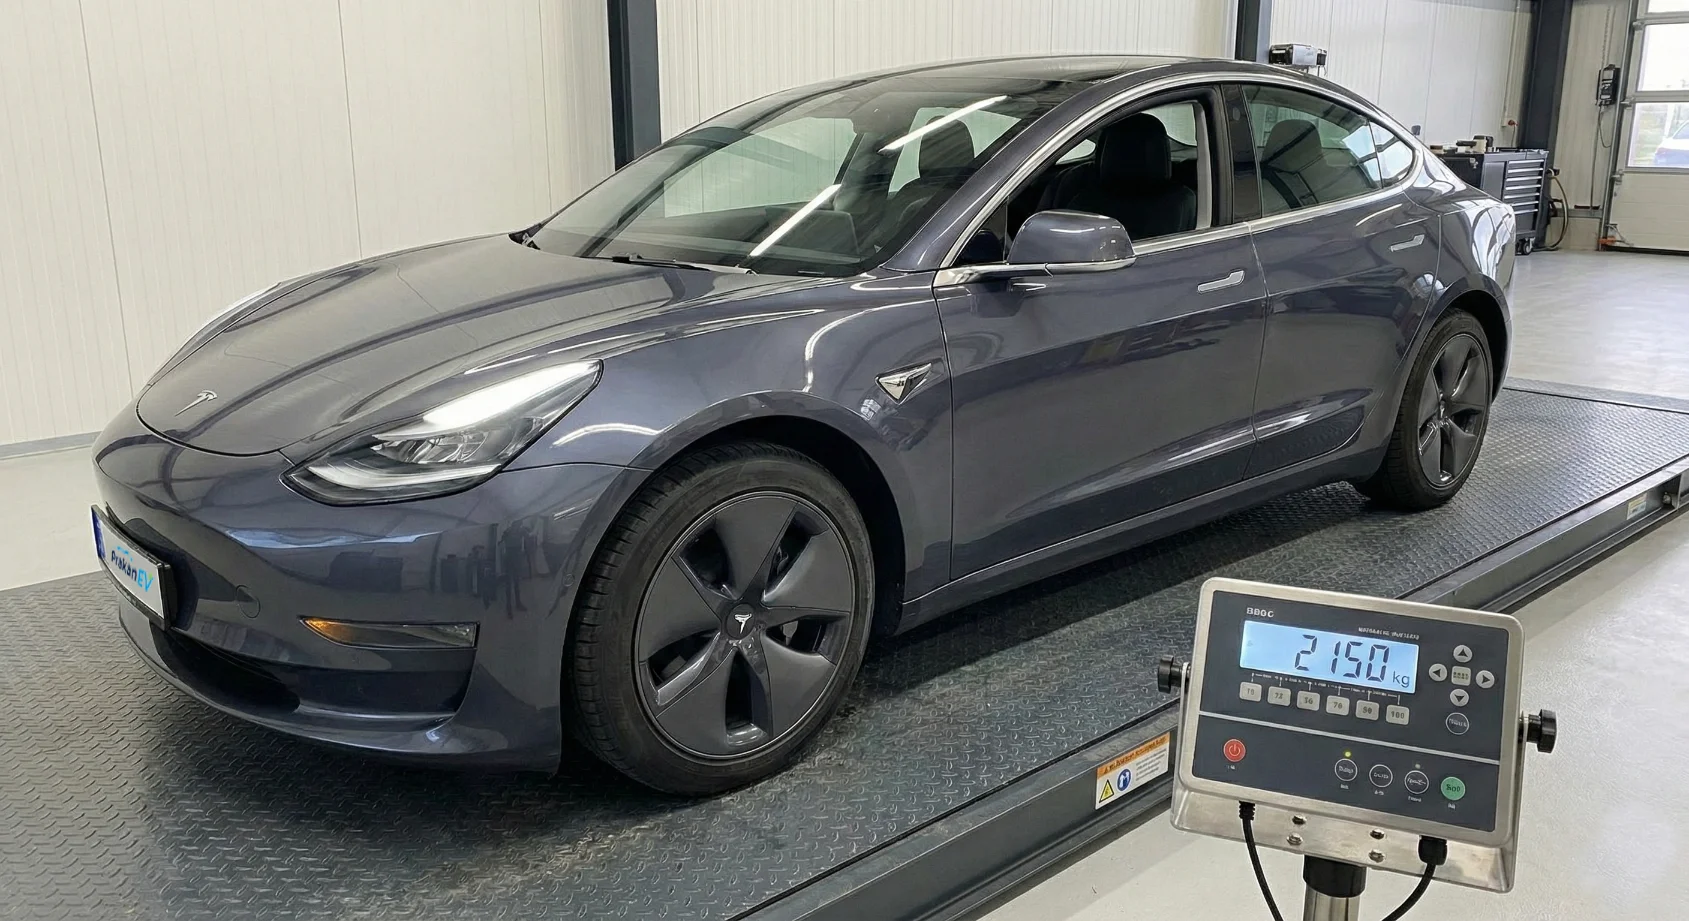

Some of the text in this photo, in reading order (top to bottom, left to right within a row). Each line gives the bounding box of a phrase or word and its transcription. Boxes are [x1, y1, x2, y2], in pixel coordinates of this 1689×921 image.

[111, 550, 154, 592] PrakanEV
[1294, 634, 1411, 688] 2150 kg
